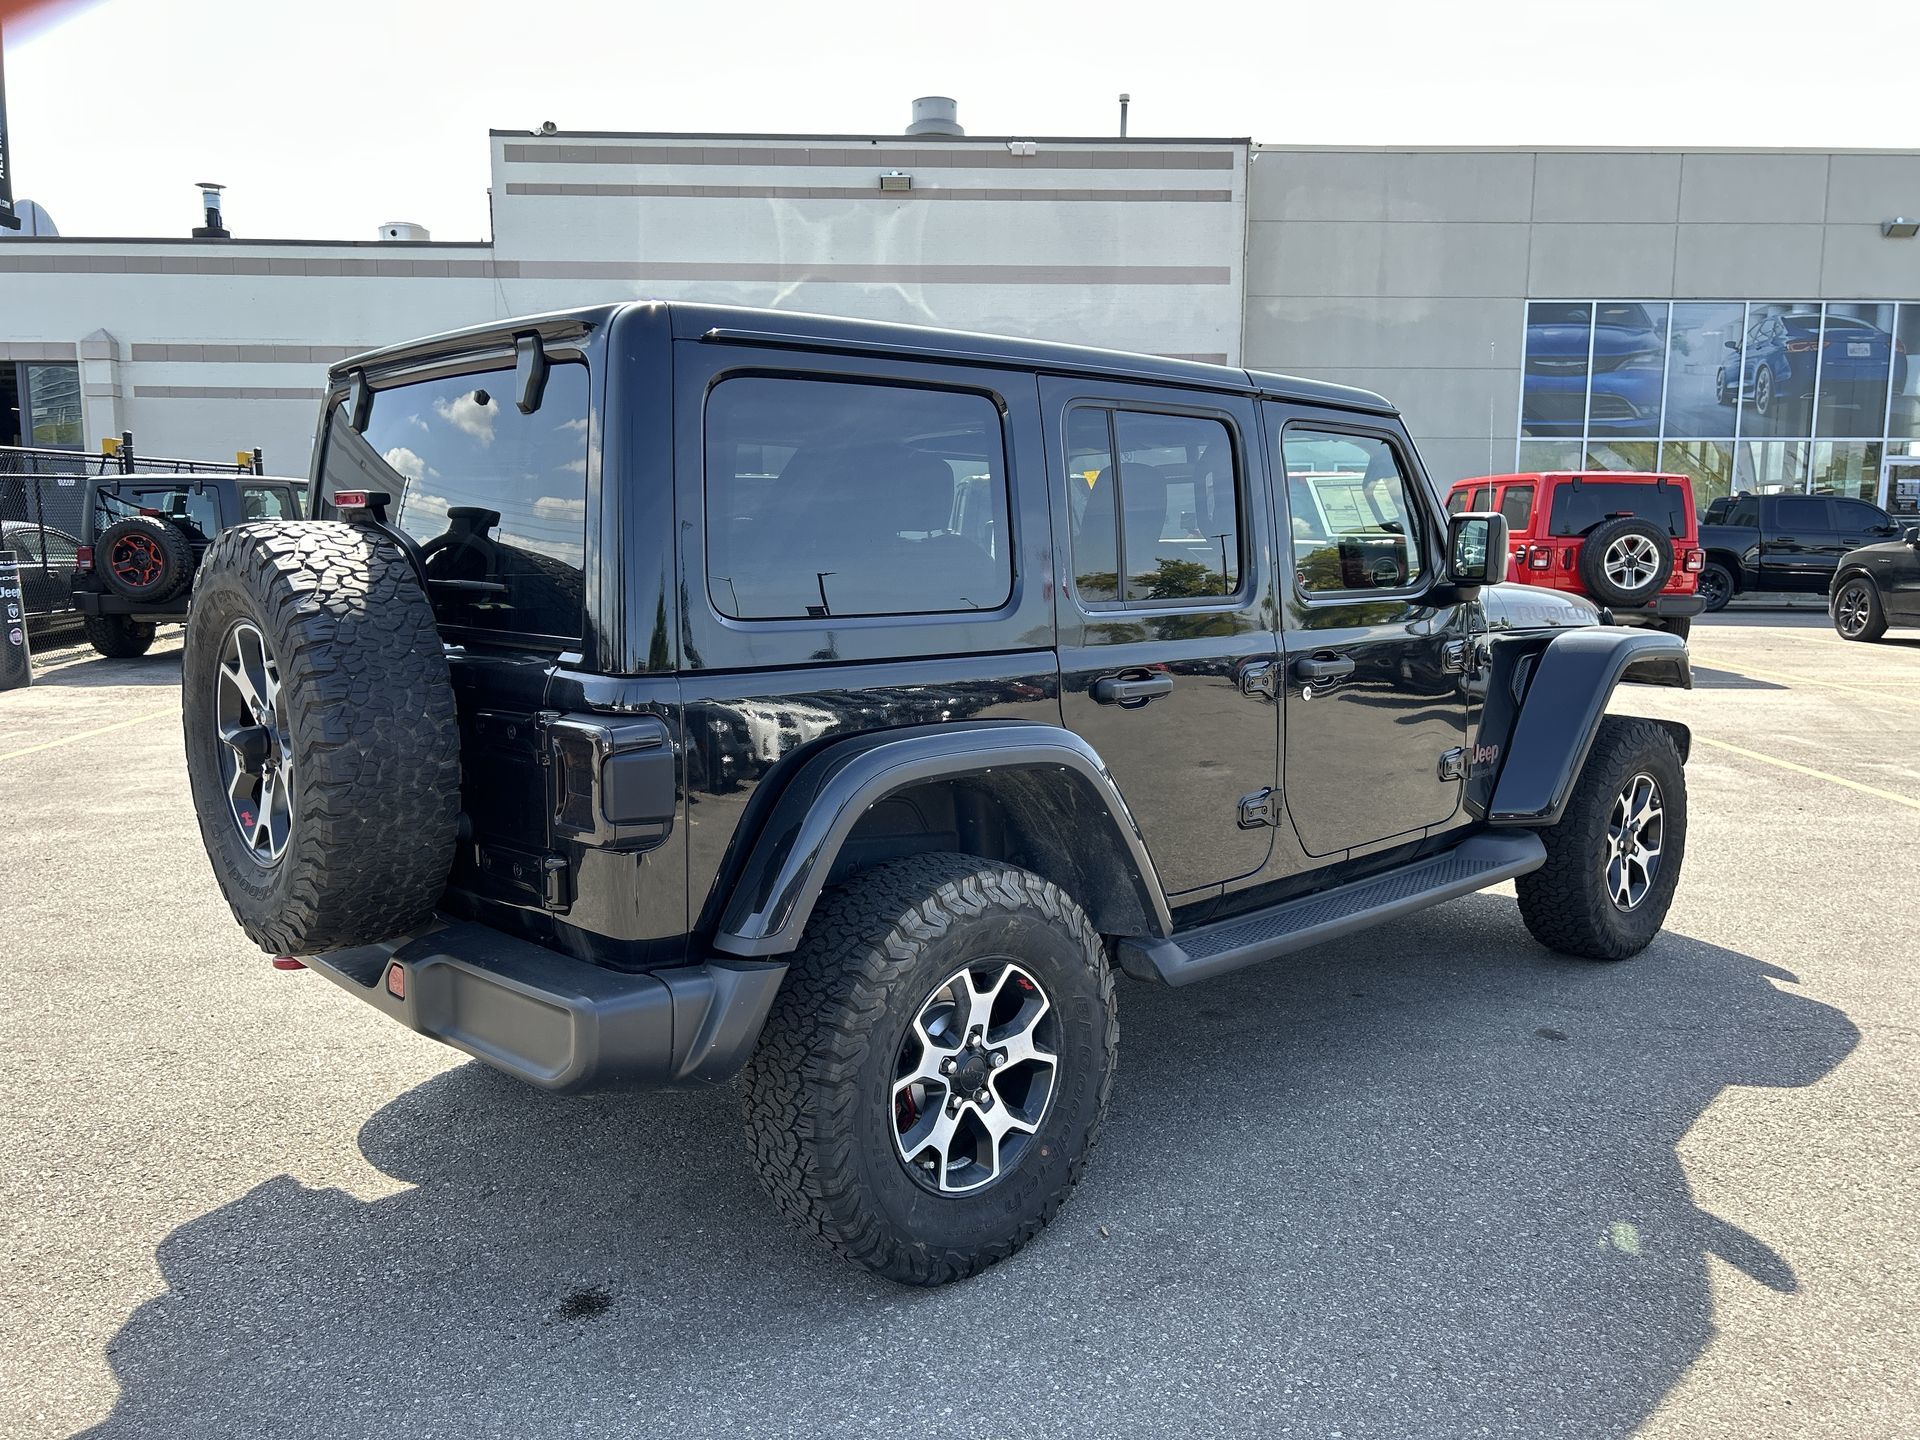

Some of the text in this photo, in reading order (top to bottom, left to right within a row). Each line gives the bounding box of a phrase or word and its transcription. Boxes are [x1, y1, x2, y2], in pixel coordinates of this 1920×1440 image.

[0, 586, 20, 598] Jeep
[1518, 605, 1598, 623] RUBICON
[1472, 743, 1500, 765] Jeep
